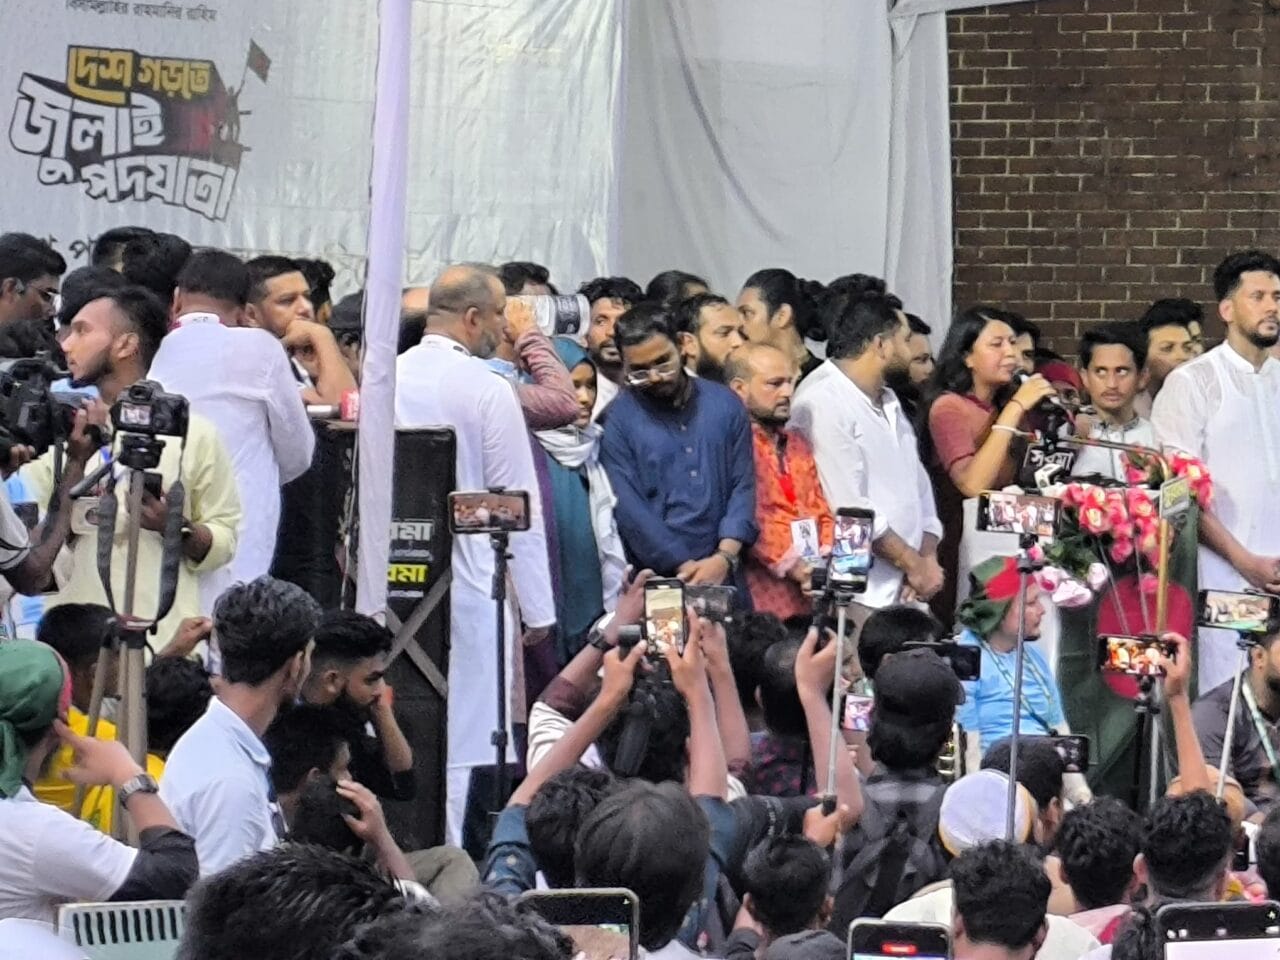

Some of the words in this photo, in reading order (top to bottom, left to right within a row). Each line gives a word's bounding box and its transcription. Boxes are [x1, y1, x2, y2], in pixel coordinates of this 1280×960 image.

[67, 47, 134, 105] দেশ
[10, 73, 166, 185] জুলাই
[81, 155, 238, 221] পদযাত্রা
